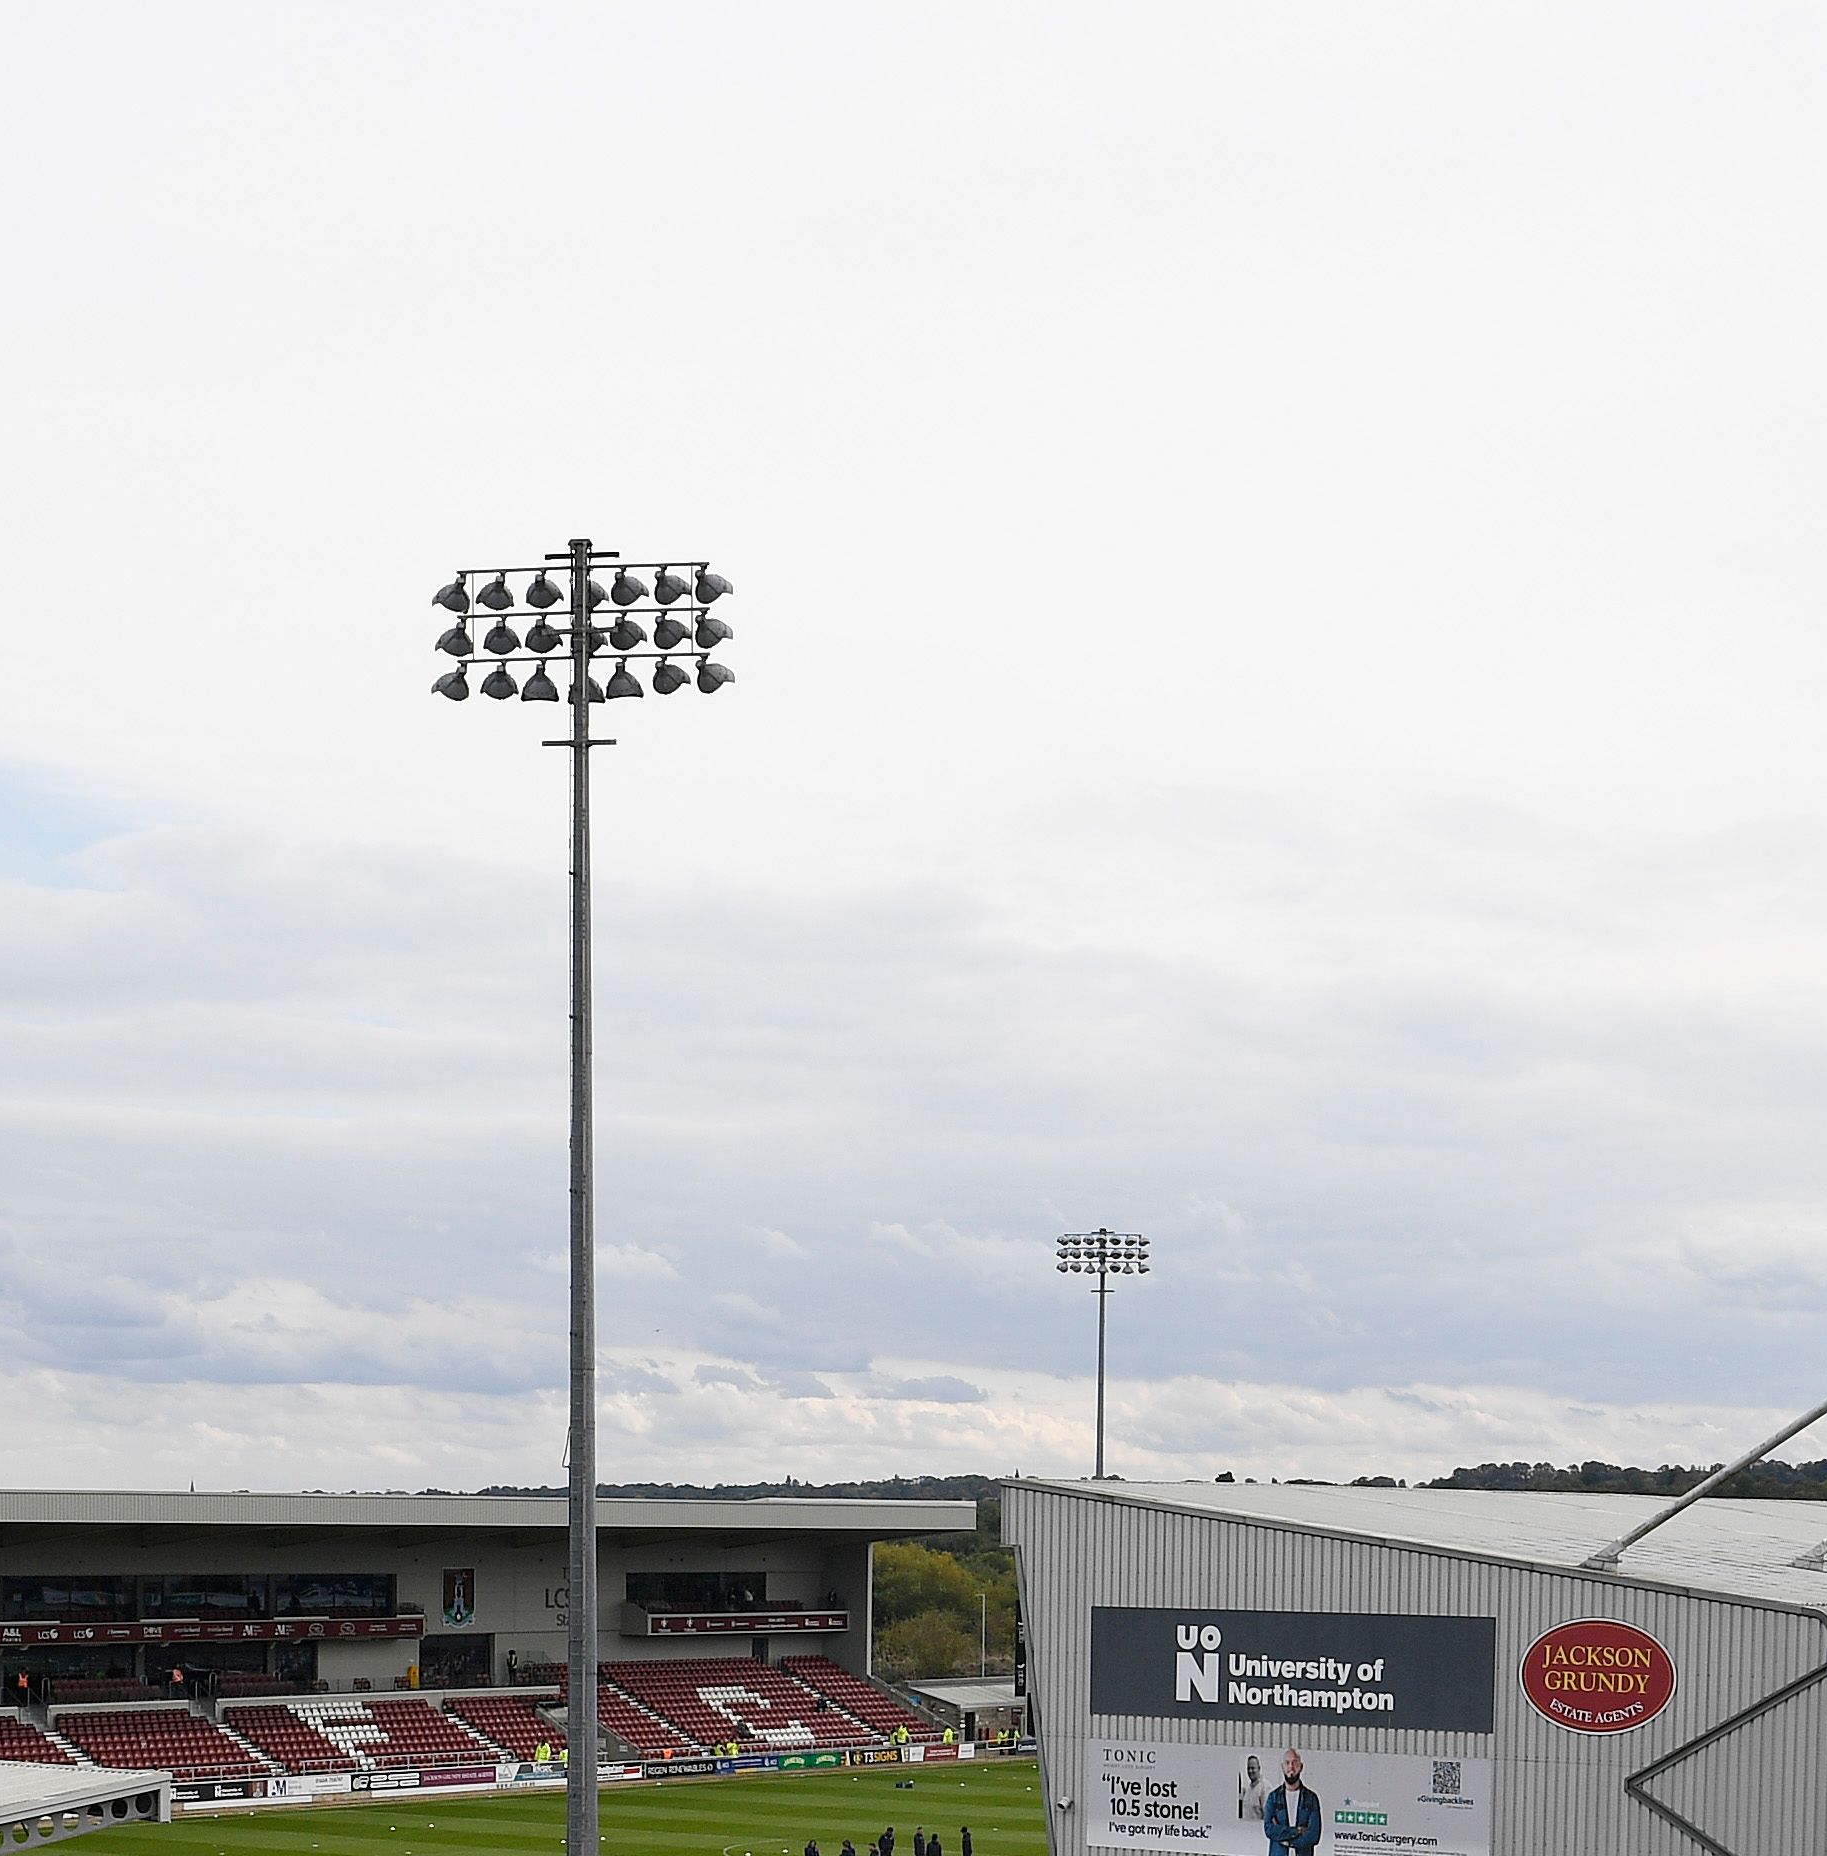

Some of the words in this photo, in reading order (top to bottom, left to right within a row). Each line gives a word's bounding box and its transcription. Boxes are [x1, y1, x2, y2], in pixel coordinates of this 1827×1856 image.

[1542, 1645, 1651, 1668] JACKSON
[1176, 1652, 1219, 1703] N
[1228, 1654, 1351, 1685] University
[1357, 1658, 1384, 1681] of
[1544, 1670, 1650, 1694] GRUNDY
[1228, 1681, 1394, 1714] Northampton
[1550, 1698, 1592, 1722] ESTATE
[1595, 1701, 1644, 1723] AGENTS
[1103, 1749, 1156, 1763] TONIC
[1146, 1777, 1177, 1798] lost
[1110, 1798, 1140, 1817] 10.5
[1144, 1801, 1199, 1820] stone!
[1109, 1822, 1126, 1833] I've
[1128, 1824, 1145, 1836] got
[1147, 1826, 1163, 1838] my
[1165, 1825, 1180, 1836] life
[1334, 1831, 1438, 1847] www.TonicSurgery.com
